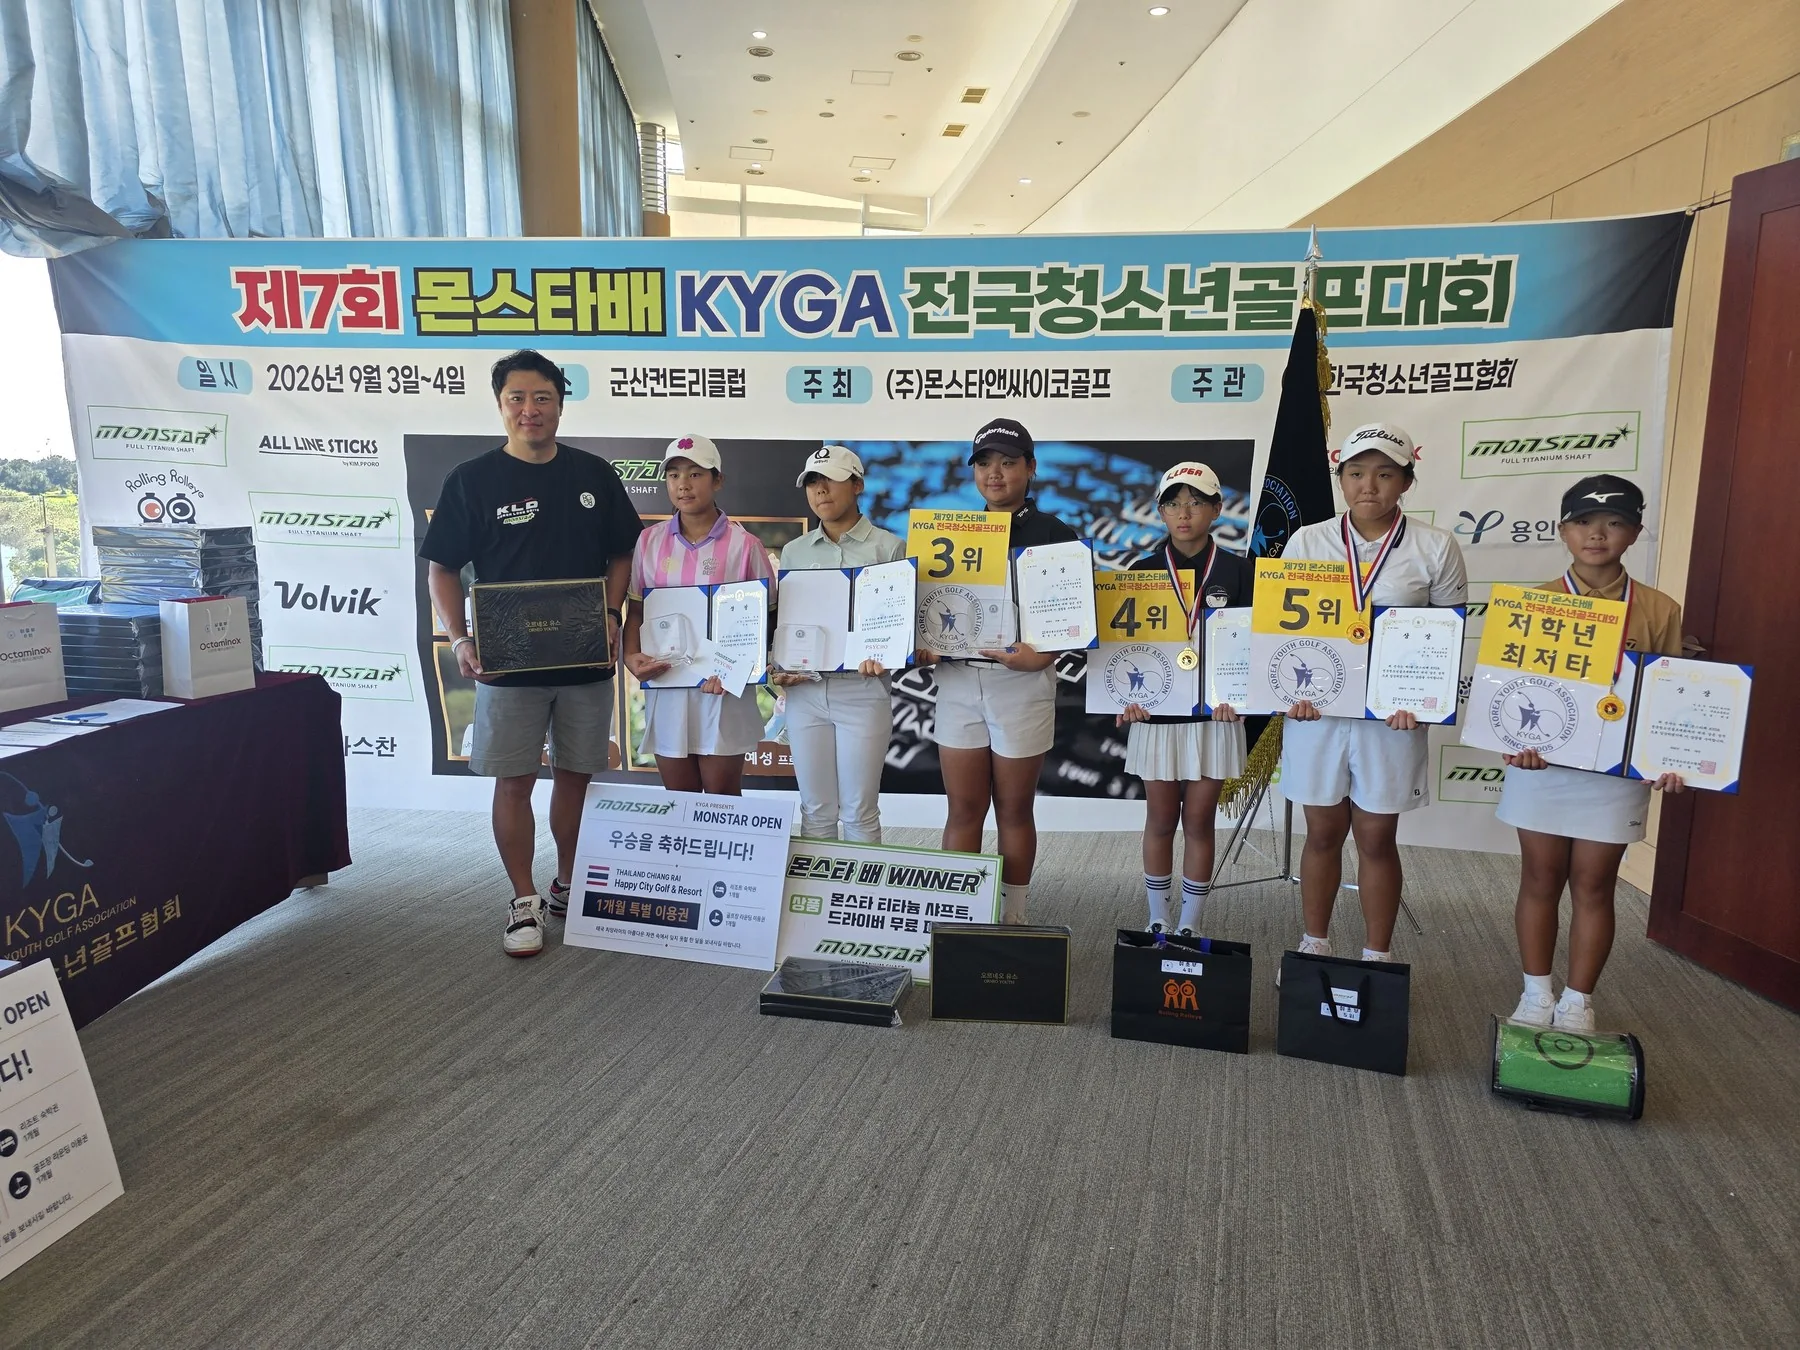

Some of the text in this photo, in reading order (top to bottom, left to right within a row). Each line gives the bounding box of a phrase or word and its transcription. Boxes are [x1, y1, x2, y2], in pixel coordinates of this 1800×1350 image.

[233, 257, 1515, 337] 제7회 몬스타배 KYGA 전국청소년골프대회
[266, 363, 466, 395] 2026년 9월 3일~4일
[610, 367, 746, 398] 군산컨트리클럽
[885, 366, 1112, 401] (주)몬스타앤싸이코골프
[259, 435, 378, 455] ALL LINE STICKS
[1350, 428, 1405, 447] Titleist
[146, 444, 176, 452] TITANIUM
[1522, 455, 1563, 464] TITANIUM
[1565, 453, 1592, 461] SHAFT
[125, 473, 167, 493] Rolling
[631, 486, 658, 494] SHAFT
[496, 500, 539, 516] KLD
[933, 513, 987, 522] 제7회 몬스타배
[912, 522, 935, 530] KYGA
[1114, 573, 1136, 581] 제7회
[1260, 571, 1286, 580] KYGA
[1284, 562, 1345, 573] 제7회 몬스타배
[273, 580, 382, 617] Volvik
[1493, 598, 1523, 610] KYGA
[1521, 591, 1550, 604] 제7회
[919, 586, 964, 634] KOREA YOUTH GOLF
[940, 633, 959, 641] KYGA
[950, 641, 969, 651] 2005
[1299, 640, 1322, 648] GOLF
[1110, 648, 1129, 670] YOUTH
[1131, 645, 1150, 653] GOLF
[1274, 642, 1297, 662] YOUTH
[1106, 671, 1116, 694] KOREA
[1270, 663, 1281, 690] KOREA
[1493, 700, 1502, 728] KOREA
[1499, 679, 1527, 699] YOUTH
[1529, 677, 1555, 689] GOLF
[1516, 731, 1542, 742] KYGA
[693, 810, 782, 830] MONSTAR OPEN
[608, 830, 754, 861] 우승을 축하드립니다!
[616, 868, 681, 882] THAILAND CHIANG RAI
[788, 855, 981, 894] 몬스타 배 WINNER
[614, 879, 703, 897] Happy City Golf & Resort
[596, 898, 689, 923] 1개월 특별 이용권
[792, 896, 822, 914] 상품
[830, 892, 873, 910] 몬스타
[877, 895, 920, 915] 티타늄
[5, 883, 100, 946] KYGA
[45, 928, 73, 948] GOLF
[75, 896, 137, 935] ASSOCIATION
[828, 911, 885, 930] 드라이버
[890, 916, 919, 933] 무료
[55, 894, 182, 980] 년골프협회
[4, 990, 51, 1025] OPEN
[19, 1103, 59, 1131] 리조트 숙박권
[23, 1127, 40, 1142] 1개월
[33, 1133, 89, 1173] 골프장 라운딩 이용권
[36, 1168, 54, 1184] 1개월
[18, 1209, 45, 1234] 보내시길
